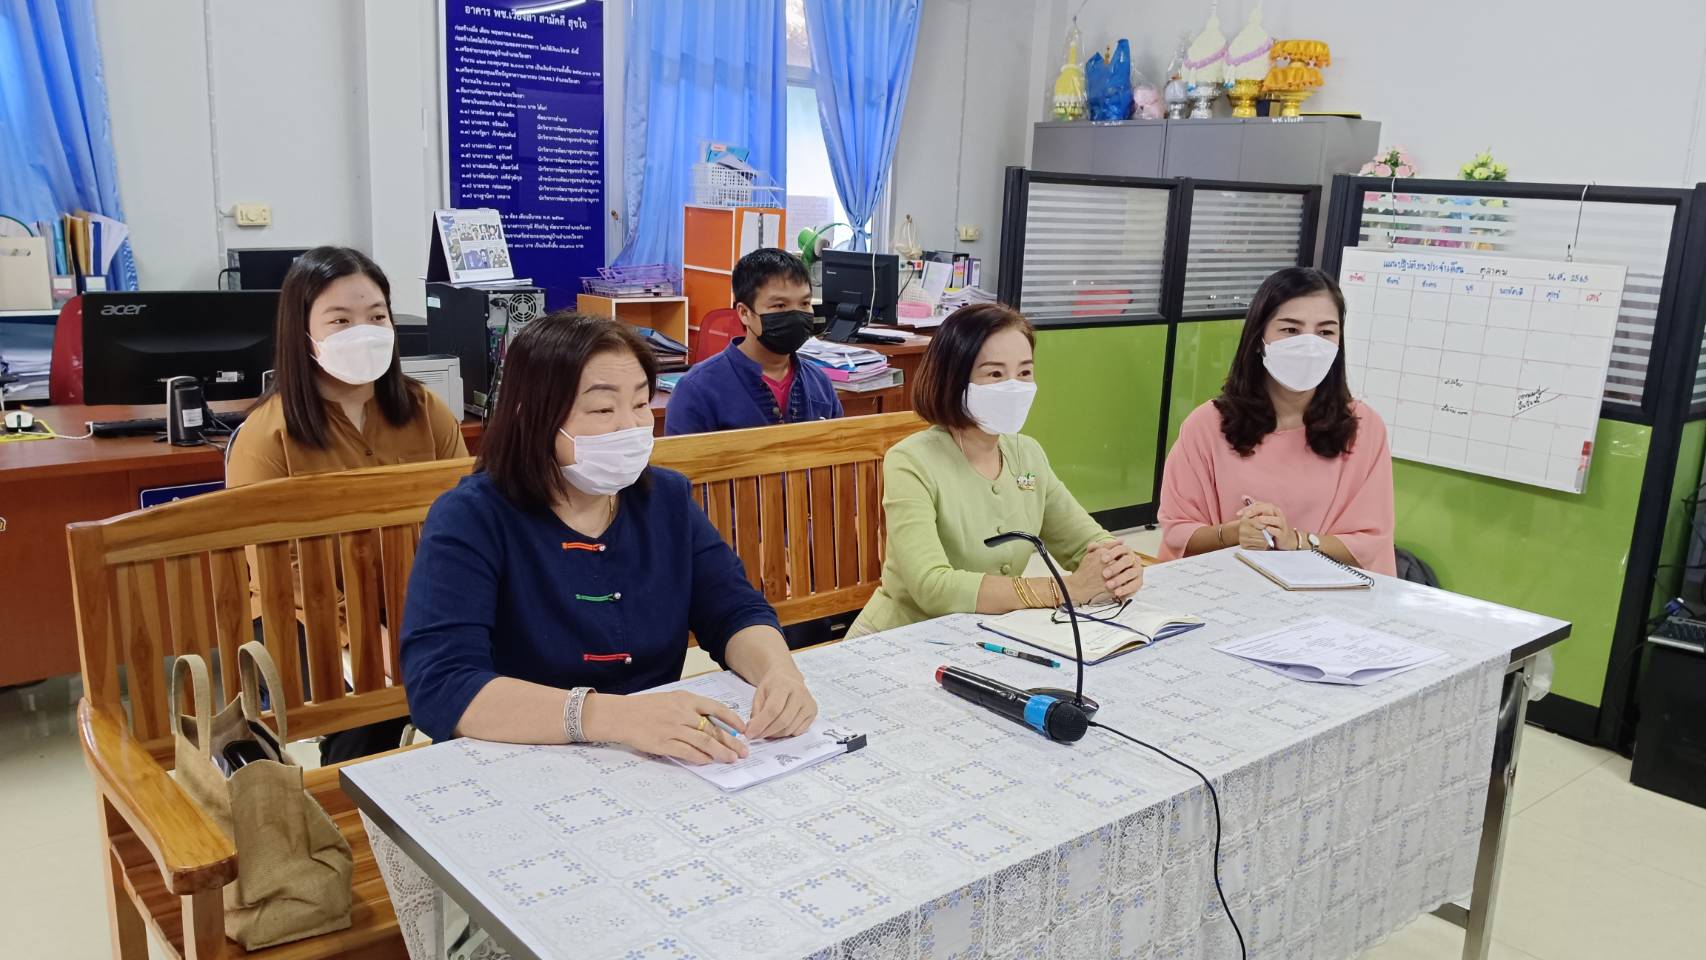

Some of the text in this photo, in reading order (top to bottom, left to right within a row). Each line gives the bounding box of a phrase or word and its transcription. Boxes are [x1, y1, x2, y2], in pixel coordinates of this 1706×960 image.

[465, 5, 491, 16] อาคาร
[539, 14, 565, 26] สามัคคี
[568, 17, 587, 30] สุขใจ
[1480, 266, 1508, 281] ตุลาคม
[100, 304, 147, 316] acer
